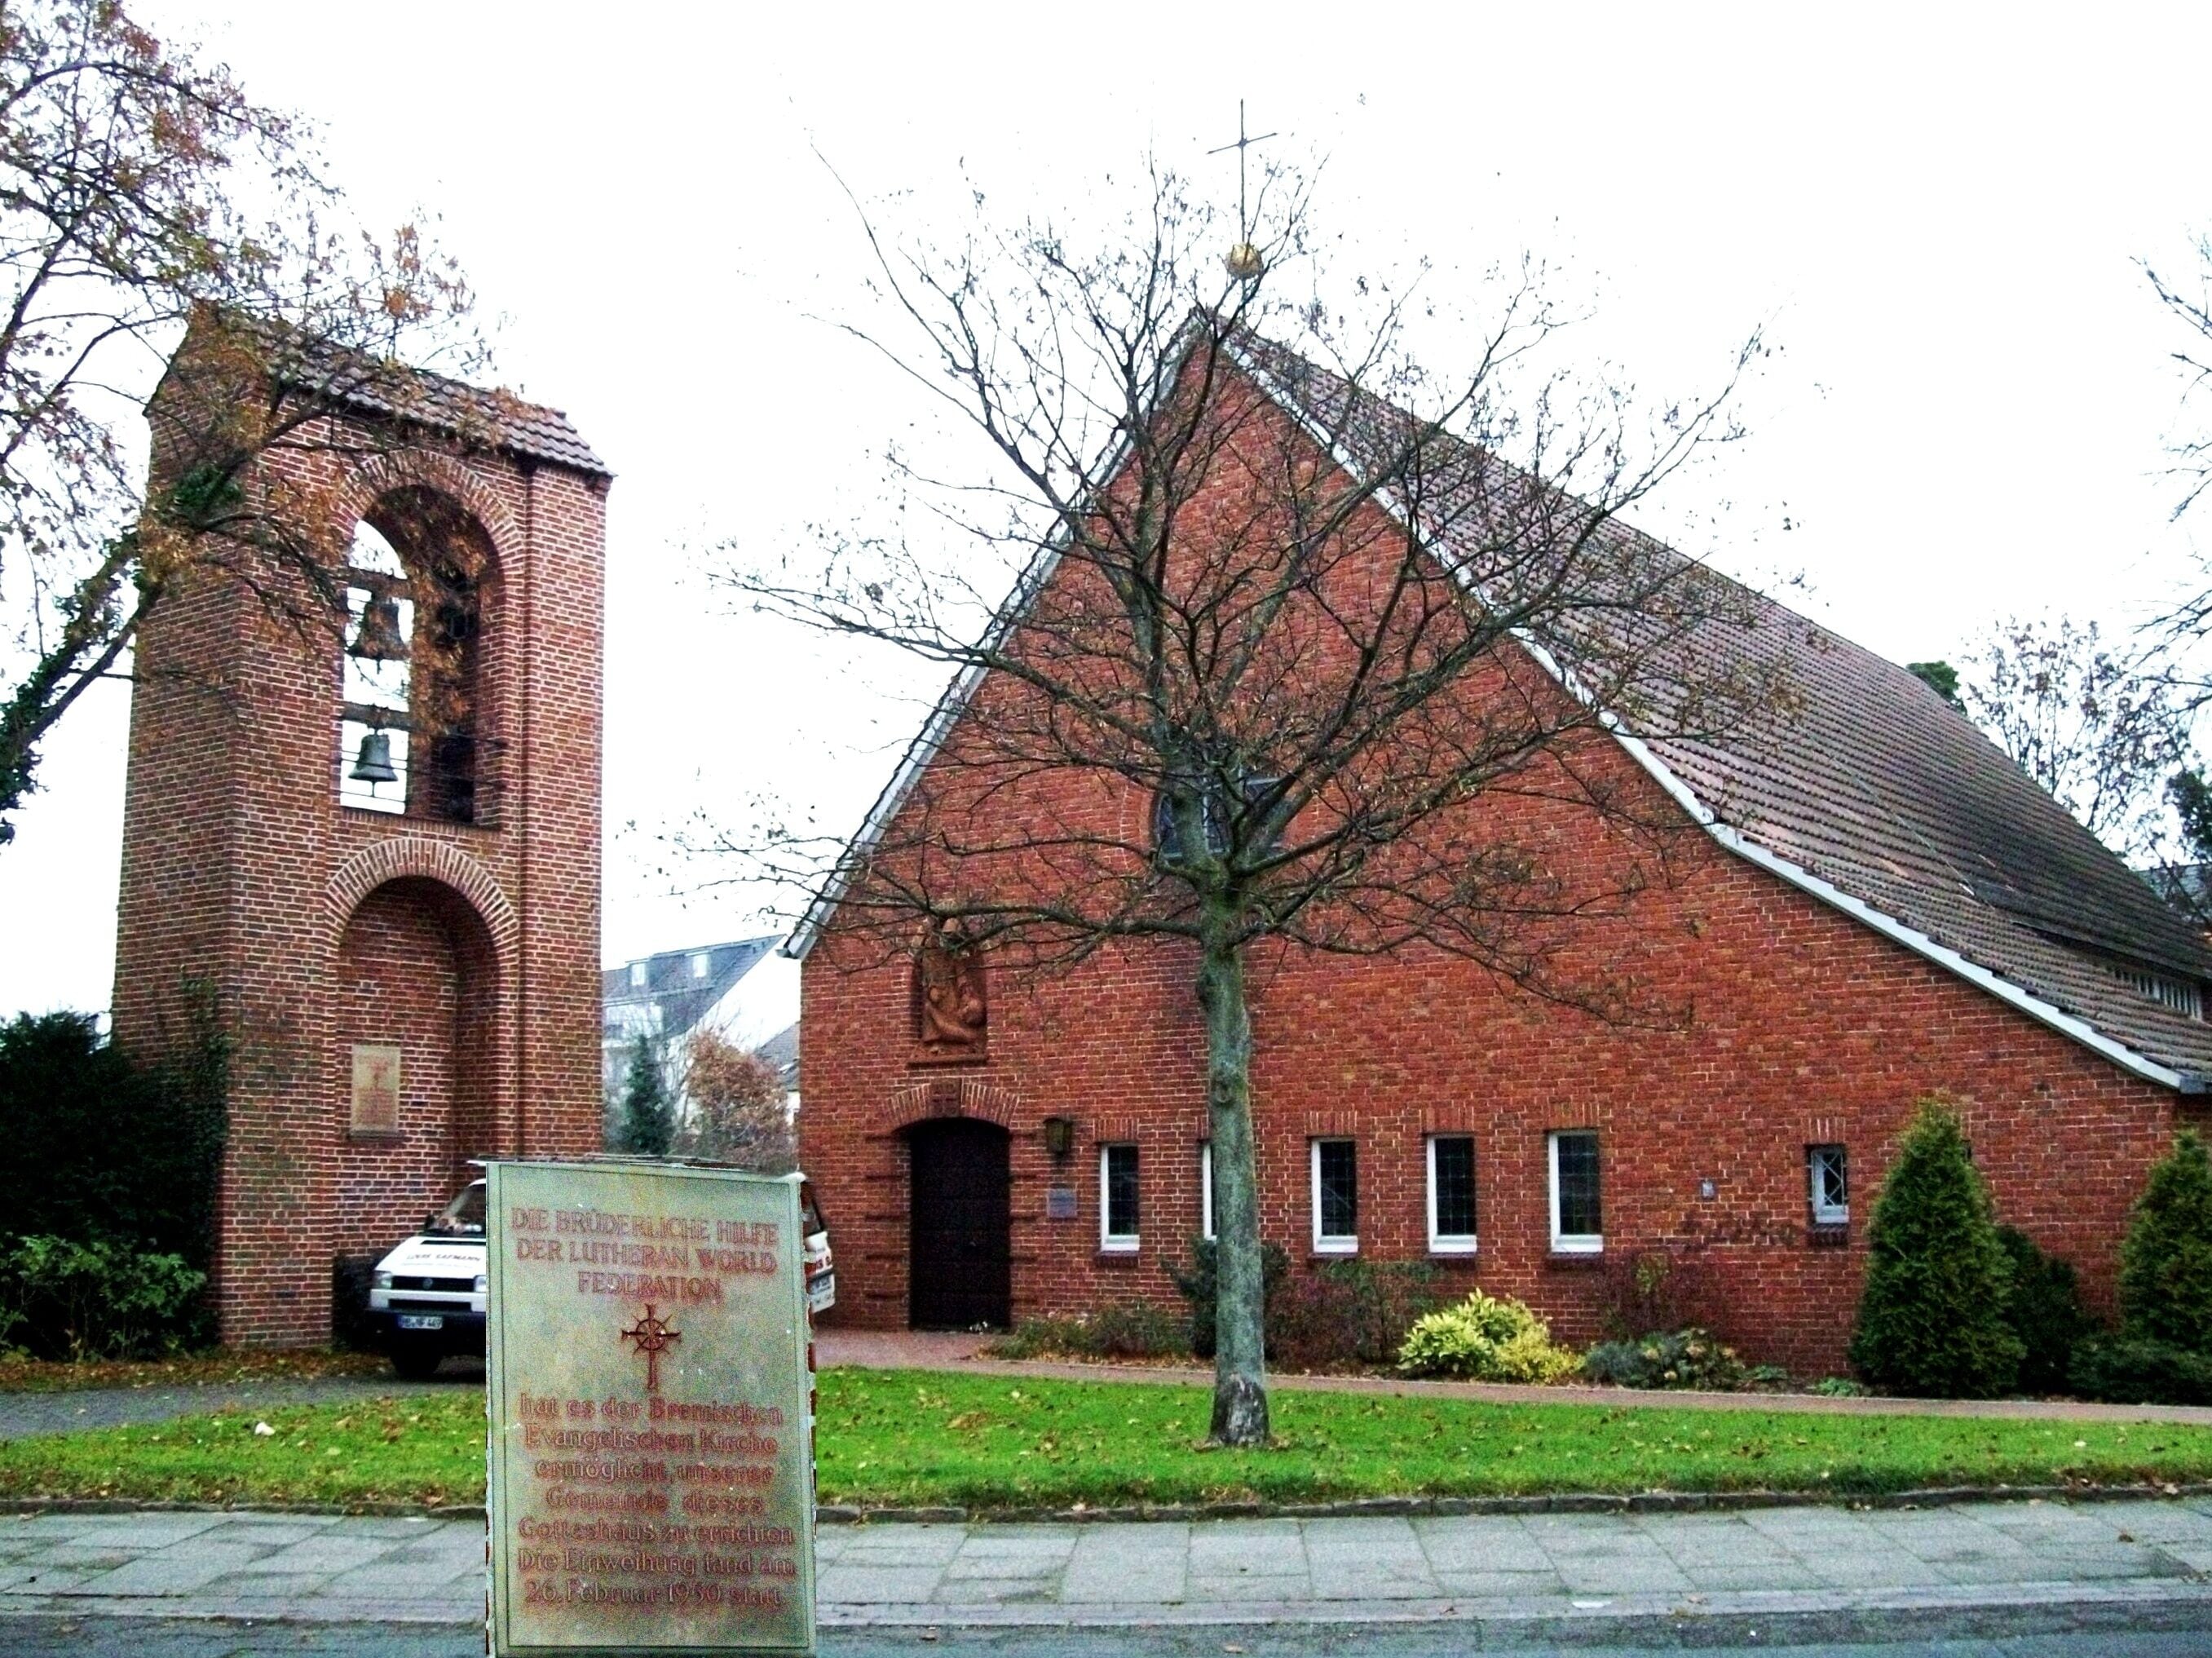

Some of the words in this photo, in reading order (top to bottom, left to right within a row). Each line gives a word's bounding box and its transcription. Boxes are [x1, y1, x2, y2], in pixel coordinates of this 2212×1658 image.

[511, 1208, 549, 1230] DIE
[555, 1209, 709, 1241] BRÜDERLICHE
[717, 1220, 779, 1245] HILFE
[517, 1239, 563, 1261] DER
[569, 1240, 689, 1270] LUTHERAN
[695, 1248, 778, 1273] WORLD
[577, 1271, 722, 1305] FEDERATION
[519, 1393, 559, 1417] hat
[566, 1399, 595, 1419] es
[601, 1396, 642, 1418] der
[648, 1397, 784, 1426] Bremischen
[524, 1425, 695, 1454] Evangelischen
[699, 1429, 779, 1454] Kirche
[545, 1487, 669, 1513] Gemeinde
[682, 1492, 765, 1514] dieses
[519, 1516, 656, 1544] Gotteshaus
[660, 1525, 689, 1545] zu
[518, 1548, 559, 1573] Die
[564, 1548, 696, 1579] Einweihung
[704, 1553, 753, 1576] fand
[758, 1556, 796, 1578] am
[668, 1582, 722, 1607] 1950
